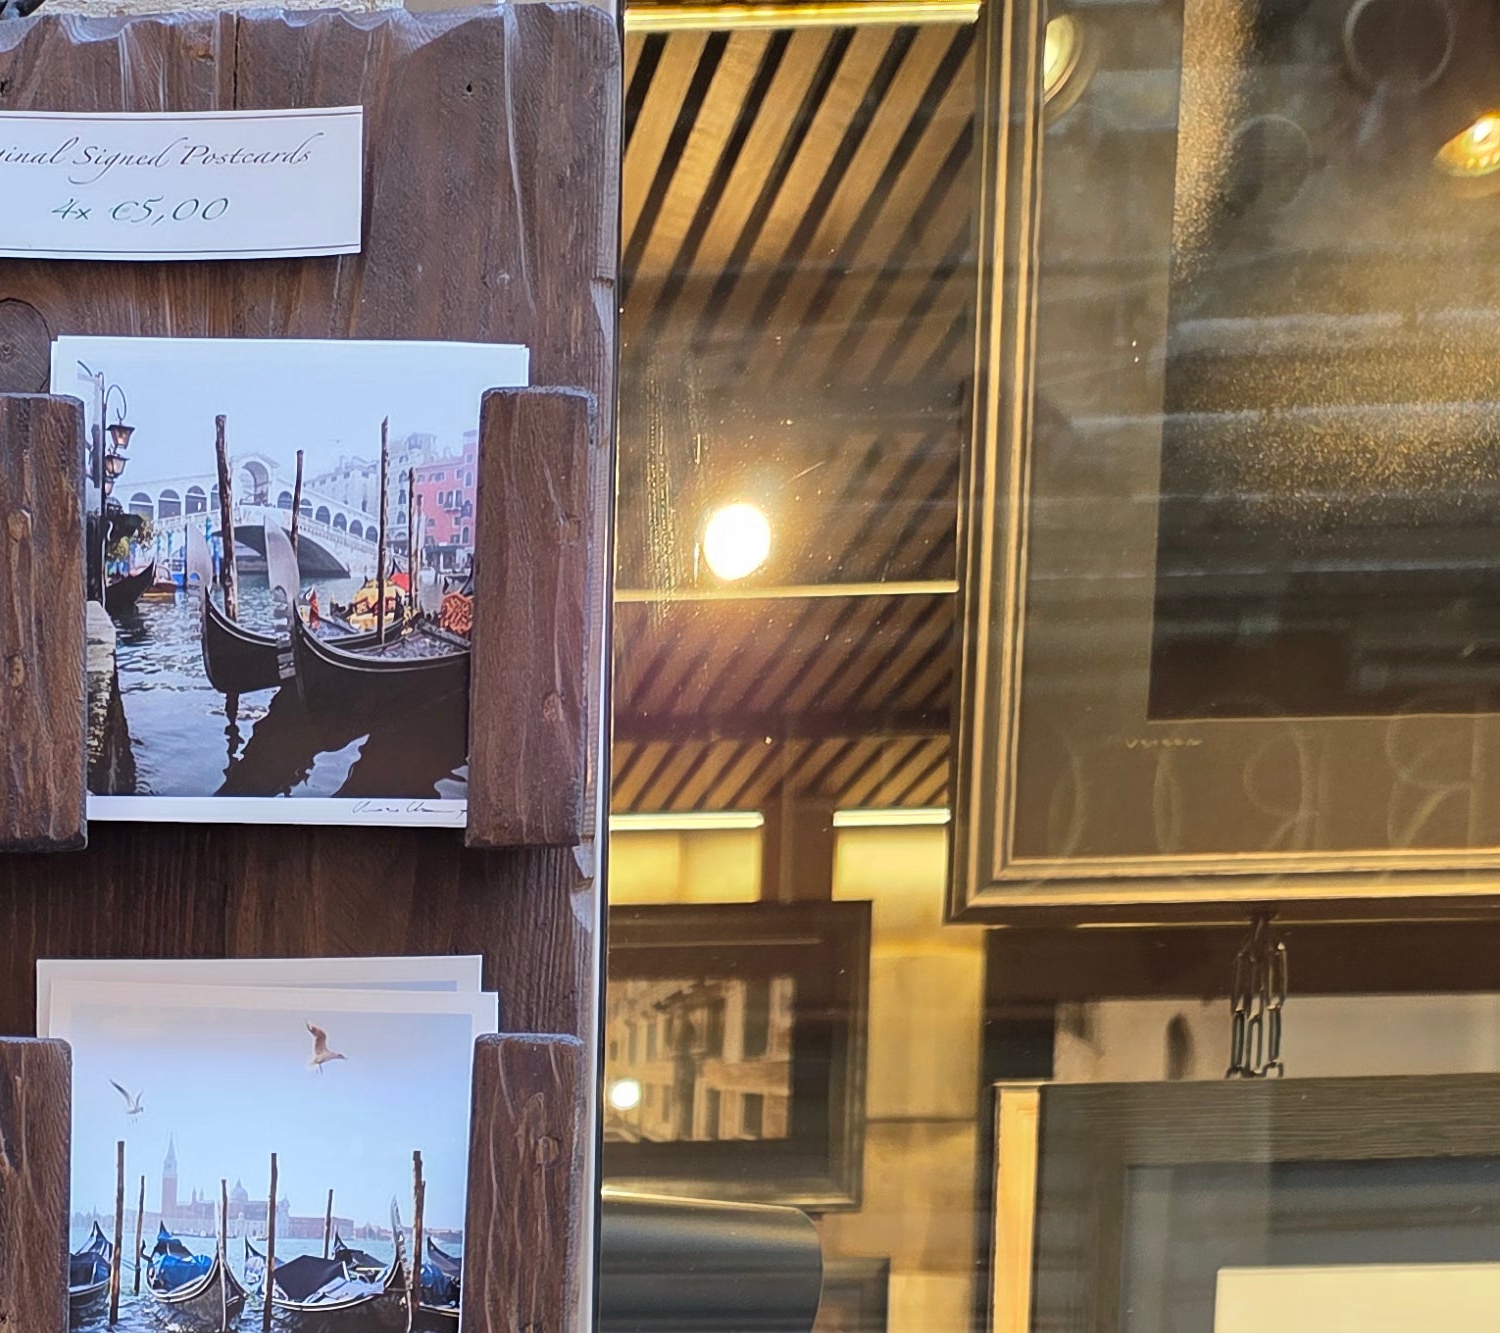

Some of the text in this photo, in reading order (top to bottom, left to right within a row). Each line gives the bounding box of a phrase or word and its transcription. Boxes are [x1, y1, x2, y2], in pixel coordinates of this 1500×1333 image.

[67, 136, 188, 185] Signed
[179, 132, 324, 166] Postcards
[51, 195, 229, 225] 4x €5,00
